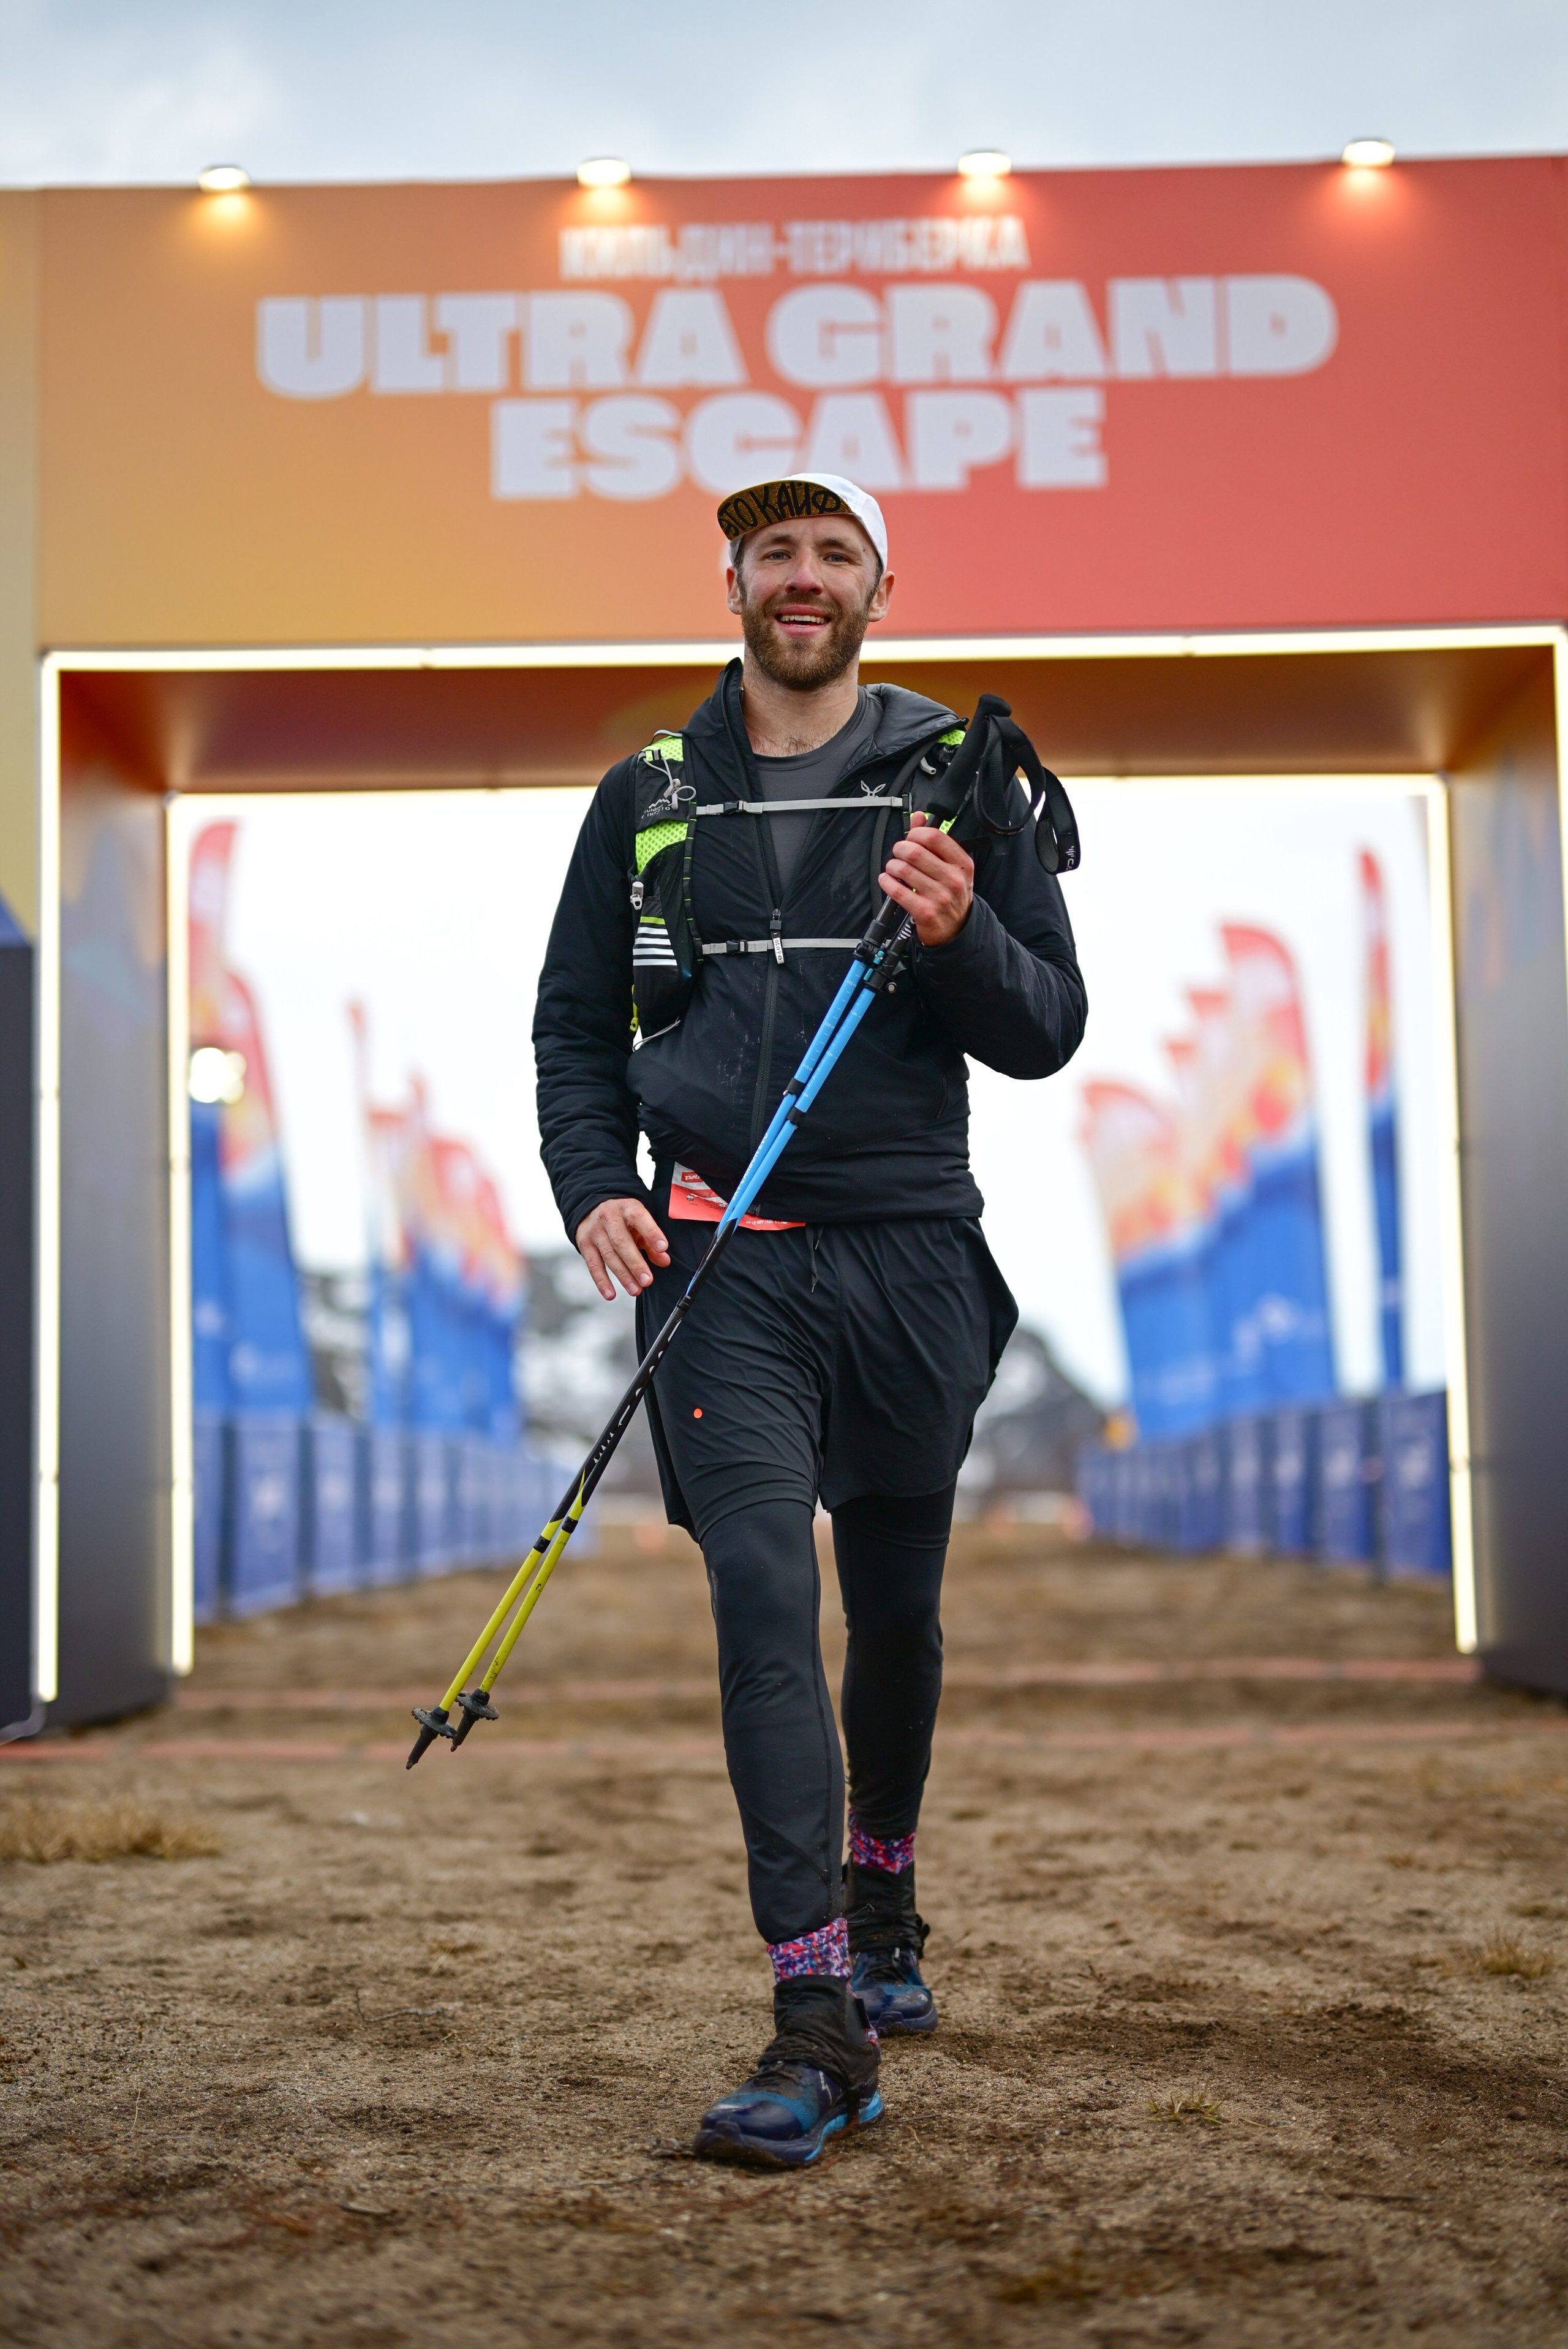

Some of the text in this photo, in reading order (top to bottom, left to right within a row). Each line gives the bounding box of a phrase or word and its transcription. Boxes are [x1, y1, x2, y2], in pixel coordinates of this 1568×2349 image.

[257, 276, 1336, 398] ULTRA GRAND
[491, 387, 1106, 500] ESCAPE
[718, 482, 842, 536] ЭТО КАЙФ
